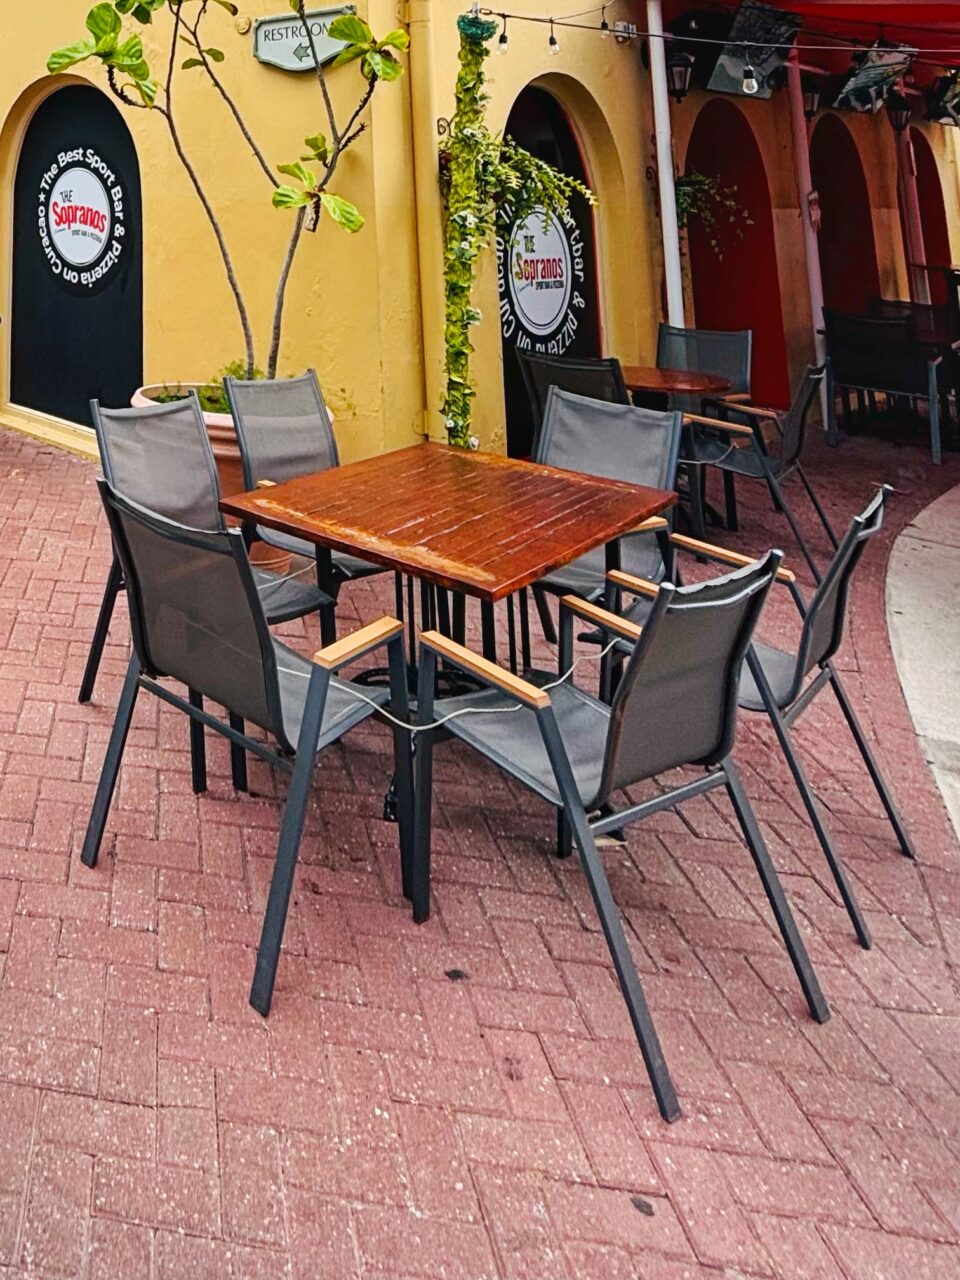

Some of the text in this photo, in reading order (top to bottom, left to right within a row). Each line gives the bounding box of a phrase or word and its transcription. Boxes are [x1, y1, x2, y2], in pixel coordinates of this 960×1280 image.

[57, 147, 83, 167] Best
[85, 149, 116, 186] Sport
[40, 163, 59, 191] The
[60, 189, 73, 203] THE
[110, 185, 124, 220] Bar
[52, 201, 107, 233] Sopranos
[114, 223, 125, 238] &
[62, 267, 79, 283] on
[80, 239, 122, 288] Pizzeria
[515, 252, 564, 288] Sopranos
